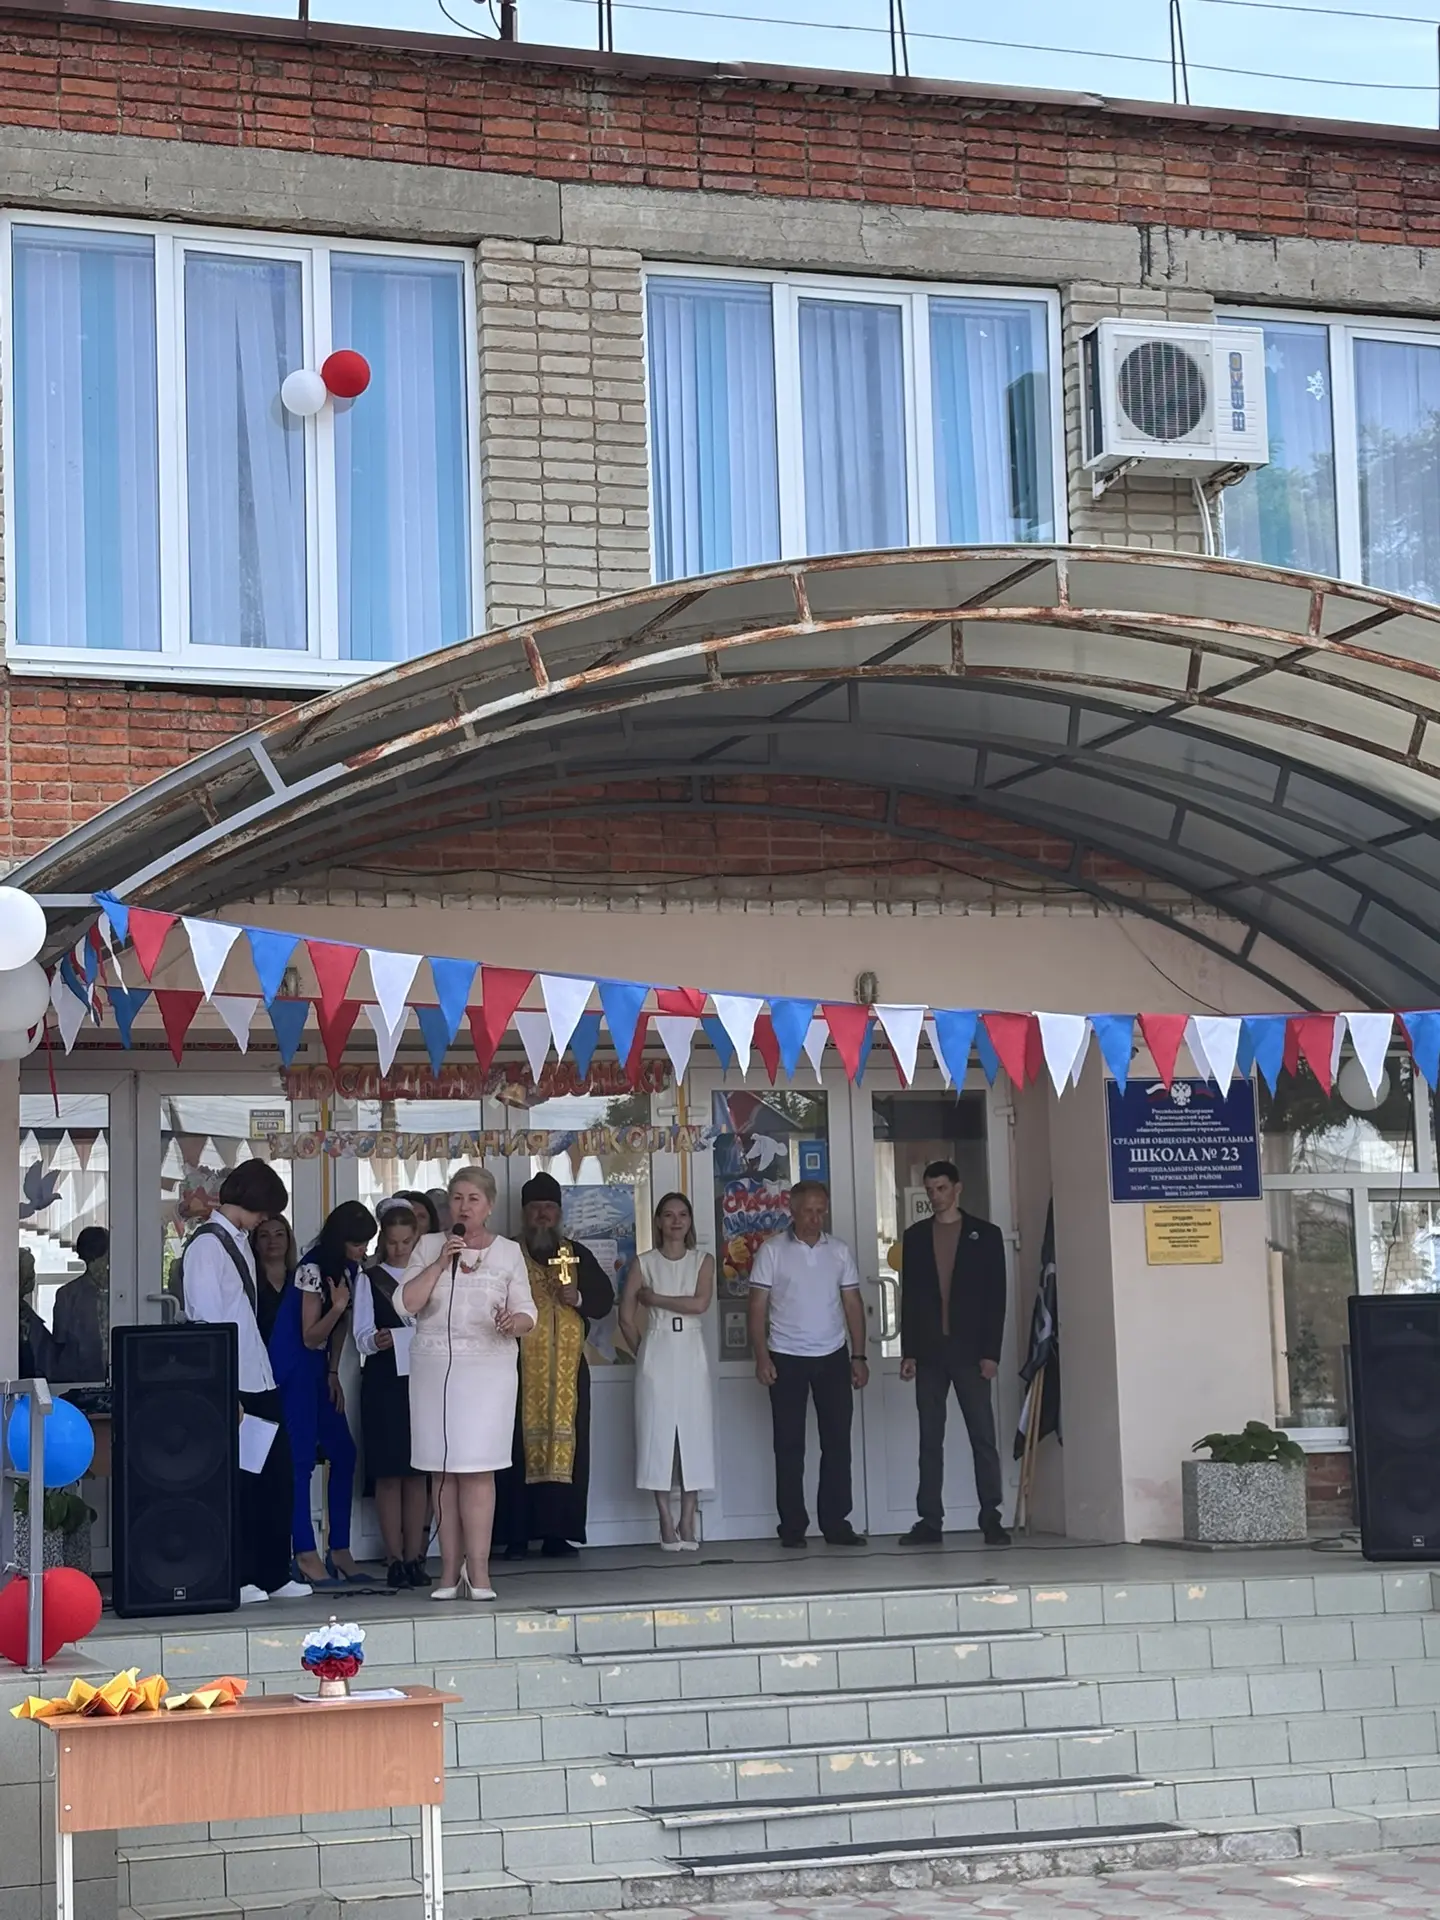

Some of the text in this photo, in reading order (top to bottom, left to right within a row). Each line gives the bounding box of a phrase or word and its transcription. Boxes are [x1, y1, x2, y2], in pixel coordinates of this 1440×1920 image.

[354, 1129, 549, 1160] СВИДАНИЯ
[1113, 1135, 1254, 1145] СРЕДНЯЯ ОБЩЕОБРАЗОВАТЕЛЬНАЯ
[1130, 1146, 1240, 1162] ШКОЛА № 23
[724, 1187, 792, 1213] СПАСИБ
[724, 1210, 790, 1235] ШКОЛ
